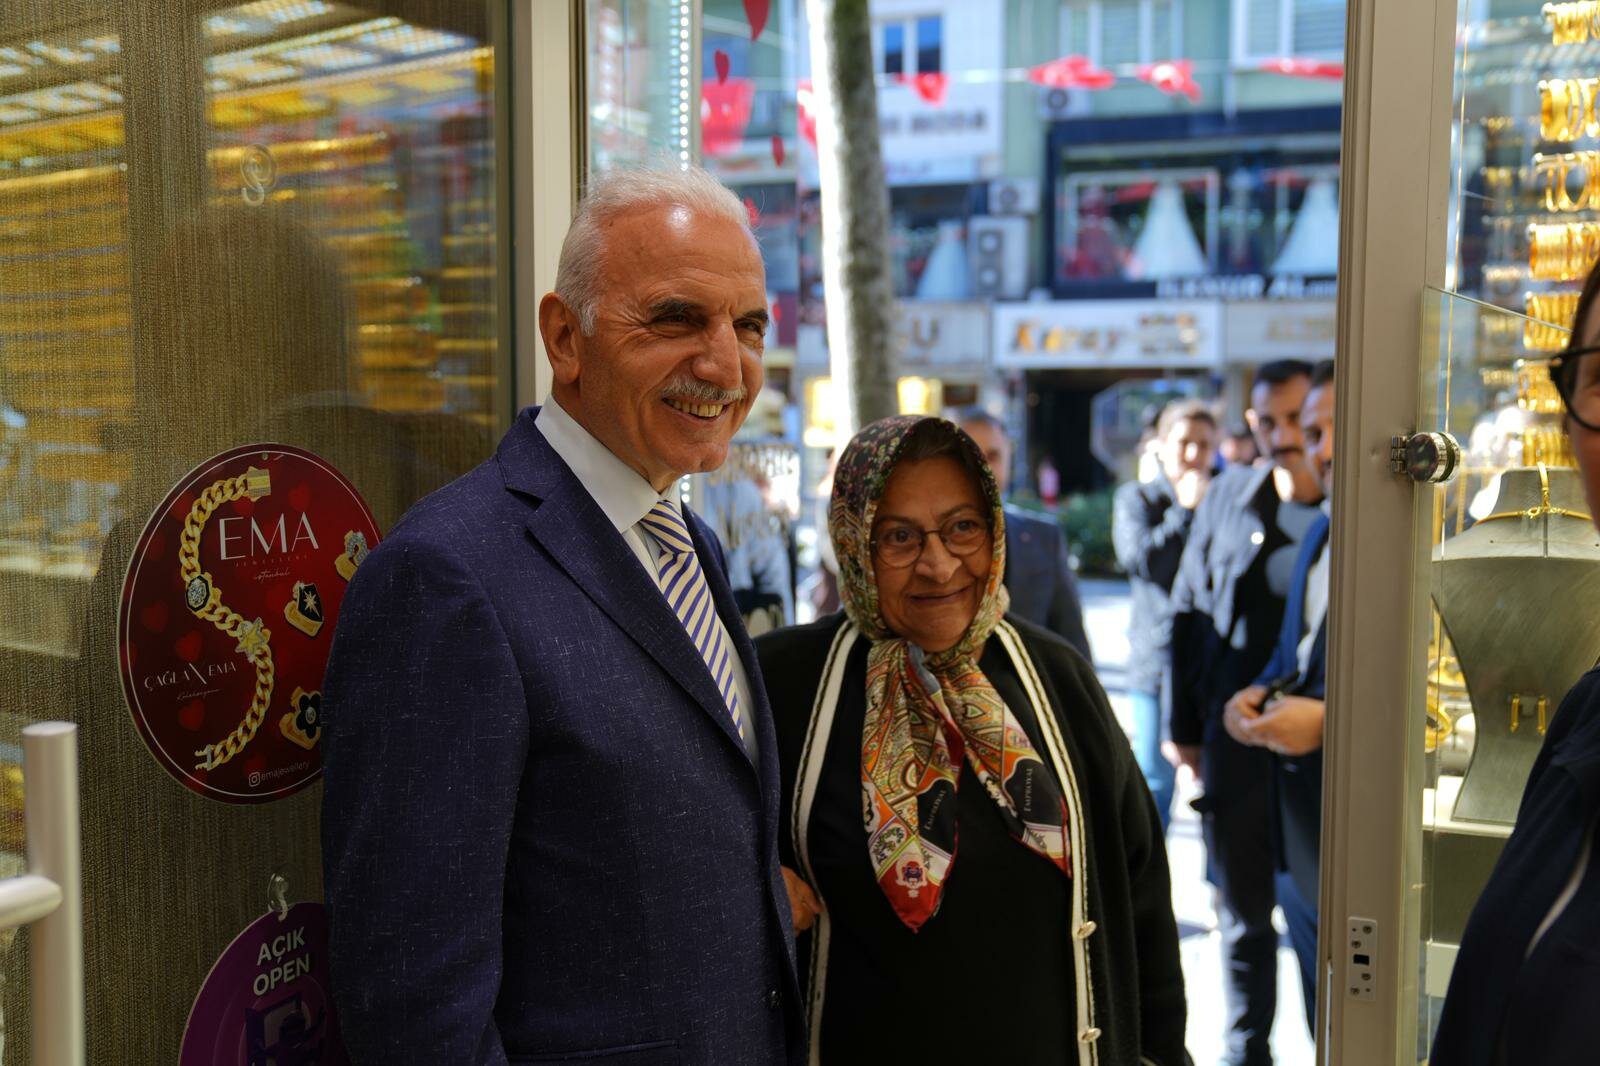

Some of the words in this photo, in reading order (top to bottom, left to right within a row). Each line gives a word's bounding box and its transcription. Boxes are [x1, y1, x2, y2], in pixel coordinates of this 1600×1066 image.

[219, 511, 319, 561] EMA
[208, 661, 237, 677] EMA
[256, 926, 305, 966] AÇIK
[253, 953, 310, 996] OPEN
